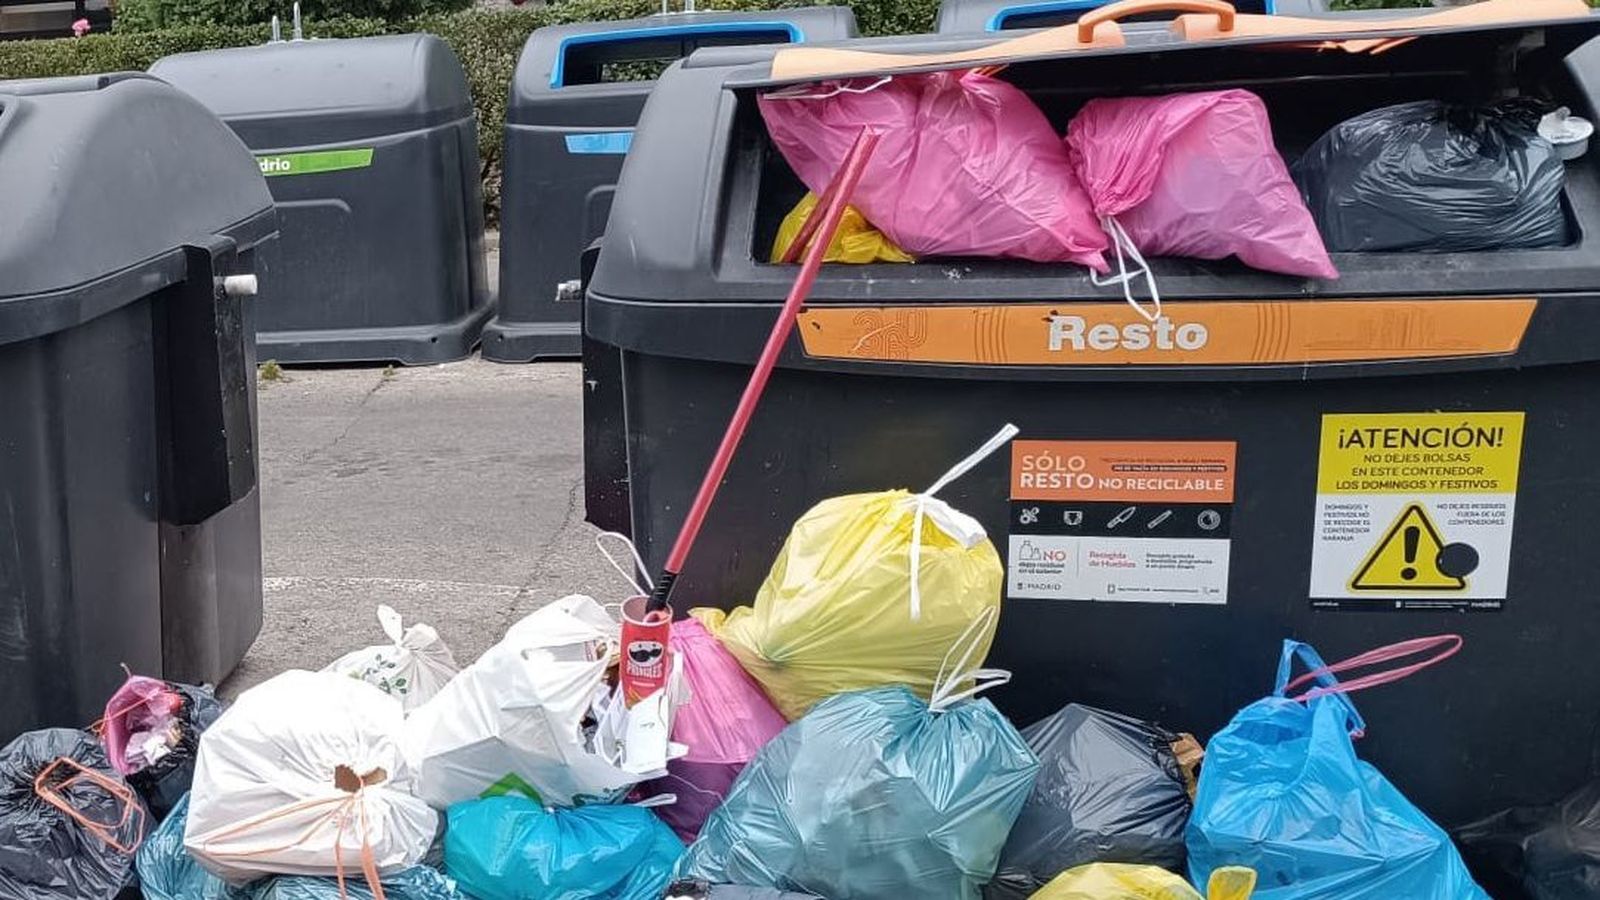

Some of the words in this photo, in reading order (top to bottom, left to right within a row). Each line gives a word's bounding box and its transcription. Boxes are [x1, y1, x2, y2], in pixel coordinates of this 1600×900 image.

[259, 157, 291, 172] drio
[1049, 315, 1209, 351] Resto
[1338, 421, 1504, 449] ¡ATENCIÓN!
[1021, 450, 1086, 472] SÓLO
[1363, 453, 1382, 464] NO
[1384, 453, 1421, 464] DEJES
[1423, 452, 1472, 463] BOLSAS
[1352, 467, 1368, 477] EN
[1370, 467, 1399, 477] ESTE
[1401, 466, 1485, 477] CONTENEDOR
[1020, 472, 1095, 490] RESTO
[1098, 478, 1124, 490] NO
[1126, 478, 1225, 491] RECICLABLE
[1335, 480, 1359, 490] LOS
[1361, 480, 1427, 490] DOMINGOS
[1430, 480, 1438, 489] Y
[1440, 479, 1499, 490] FESTIVOS
[1043, 550, 1067, 561] NO
[626, 661, 664, 679] PRINGLES
